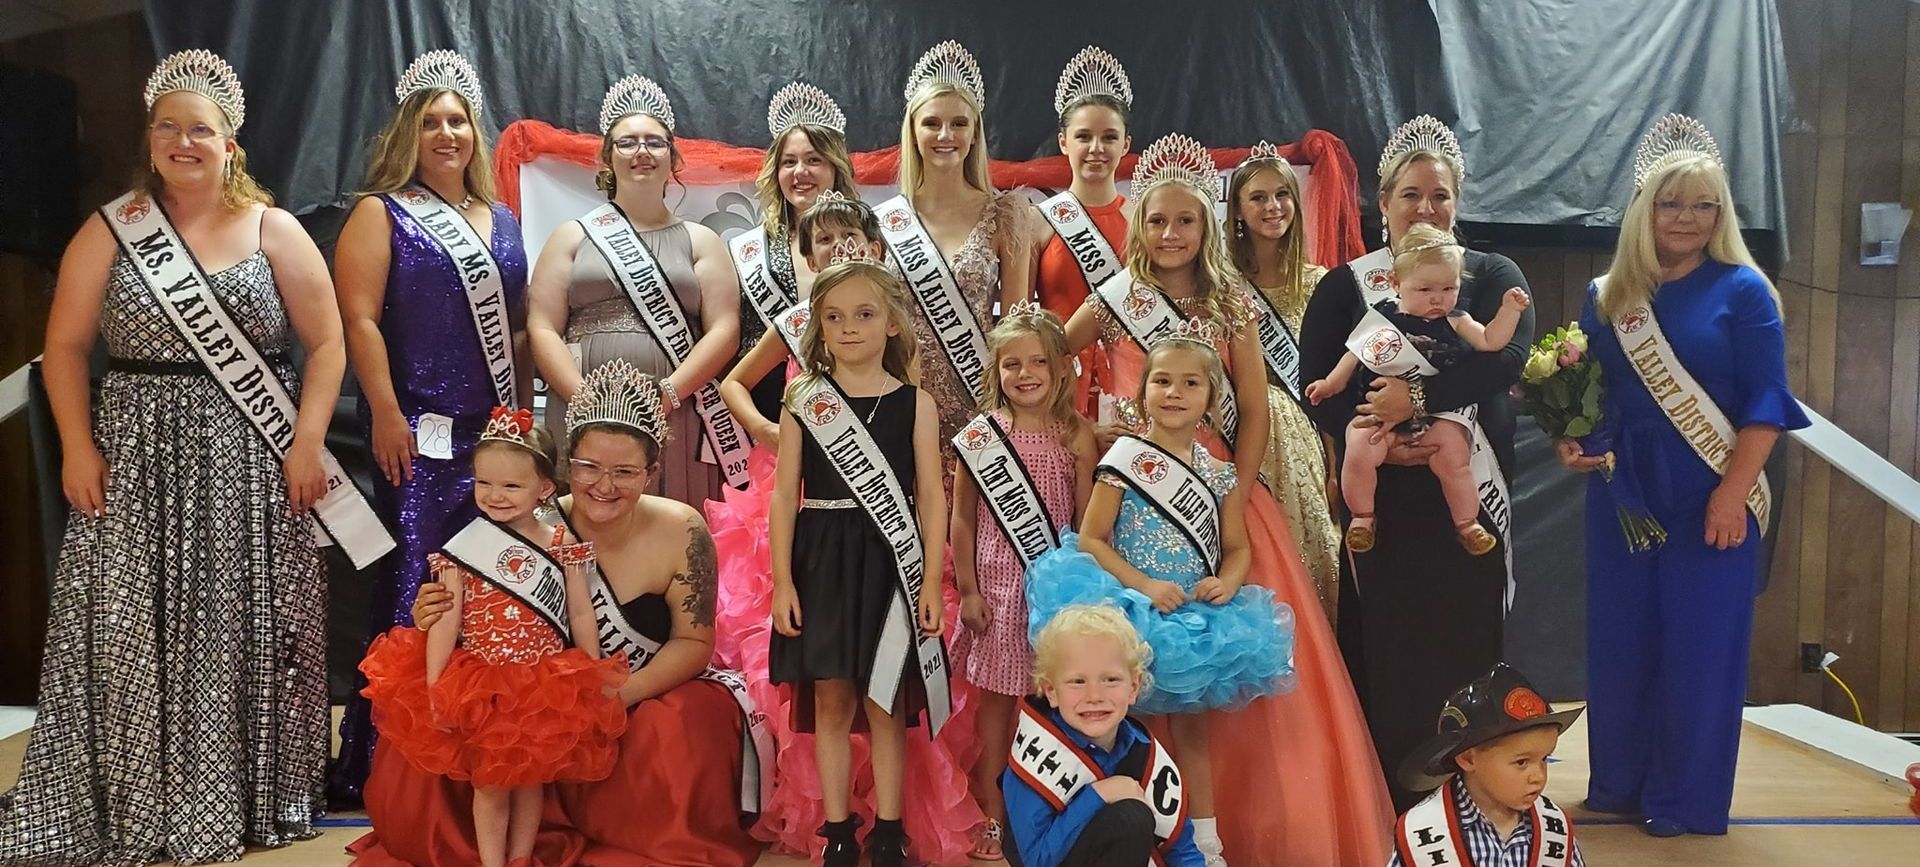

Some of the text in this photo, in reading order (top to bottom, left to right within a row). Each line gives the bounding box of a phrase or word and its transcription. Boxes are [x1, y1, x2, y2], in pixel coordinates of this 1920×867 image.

[1065, 227, 1106, 273] MISS
[131, 227, 173, 276] MS.
[162, 272, 246, 371] VALLEY
[418, 208, 472, 254] LADY
[458, 249, 490, 292] MS.
[474, 291, 506, 367] VALLEY
[745, 263, 773, 307] TEEN
[893, 234, 928, 276] MISS
[914, 267, 962, 335] VALLEY
[603, 228, 640, 268] VALLEY
[629, 265, 679, 330] DISTRICT
[710, 408, 741, 454] QUEEN
[1268, 336, 1294, 370] MISS
[419, 417, 450, 453] 28
[1629, 334, 1683, 405] VALLEY
[1668, 393, 1734, 469] DISTRICT
[824, 426, 876, 483] VALLEY
[860, 470, 907, 544] DISTRICT
[894, 530, 916, 562] JR.
[977, 455, 1012, 495] TINY
[995, 482, 1031, 522] MISS
[1168, 476, 1208, 525] VALLEY
[924, 652, 941, 680] 2021
